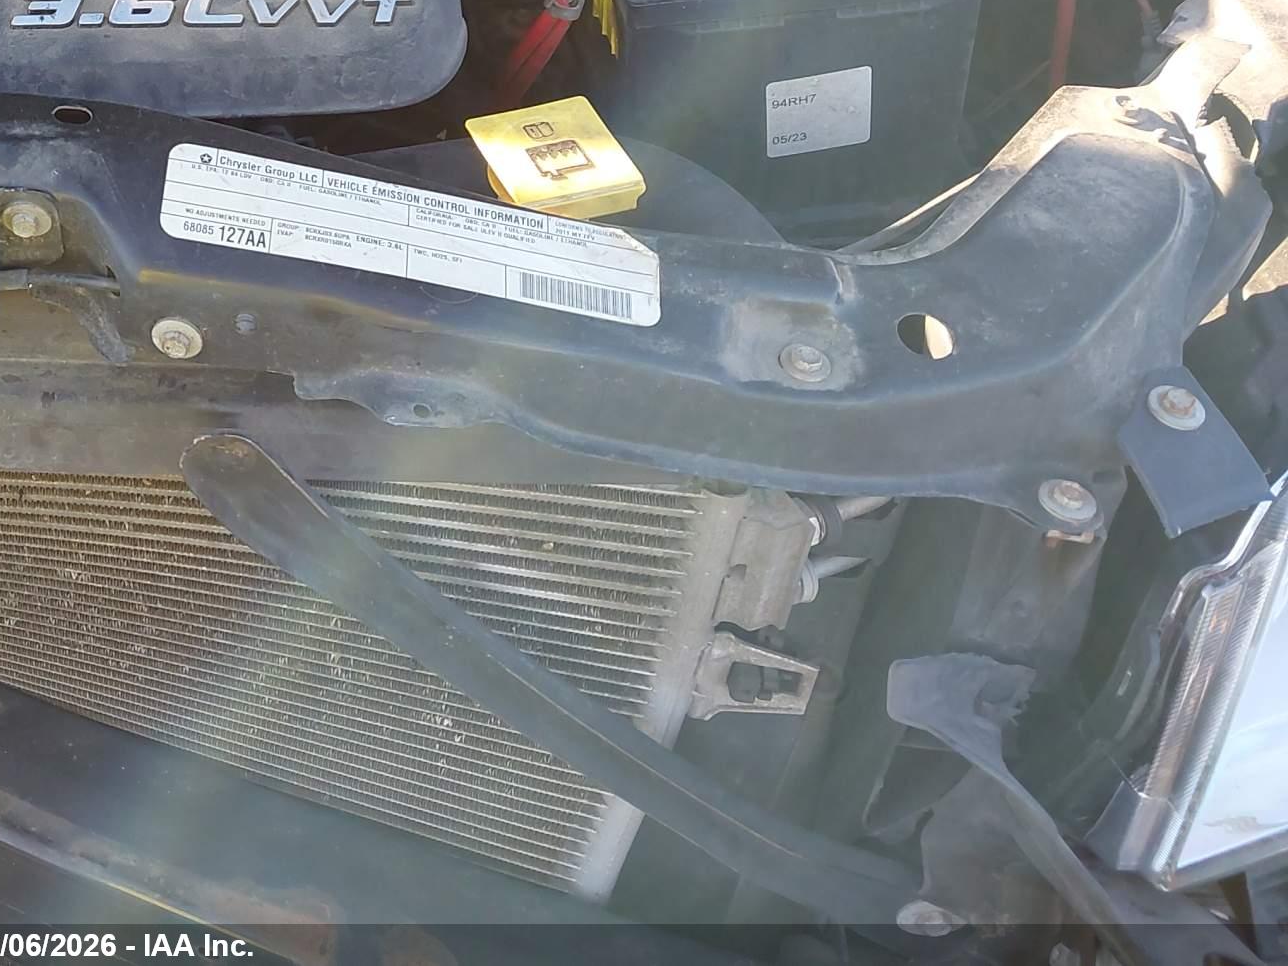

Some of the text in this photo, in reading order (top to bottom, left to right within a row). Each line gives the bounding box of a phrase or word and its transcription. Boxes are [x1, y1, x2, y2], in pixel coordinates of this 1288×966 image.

[772, 94, 817, 109] 94RH7
[772, 132, 808, 145] 05/23
[219, 155, 544, 229] Chrysler Group LLC VEHICLE EMISSION CONTROL INFORMATION
[196, 208, 239, 222] ADJUSTMENTS
[241, 217, 265, 226] NEEDED
[182, 220, 268, 249] 68085 127AA
